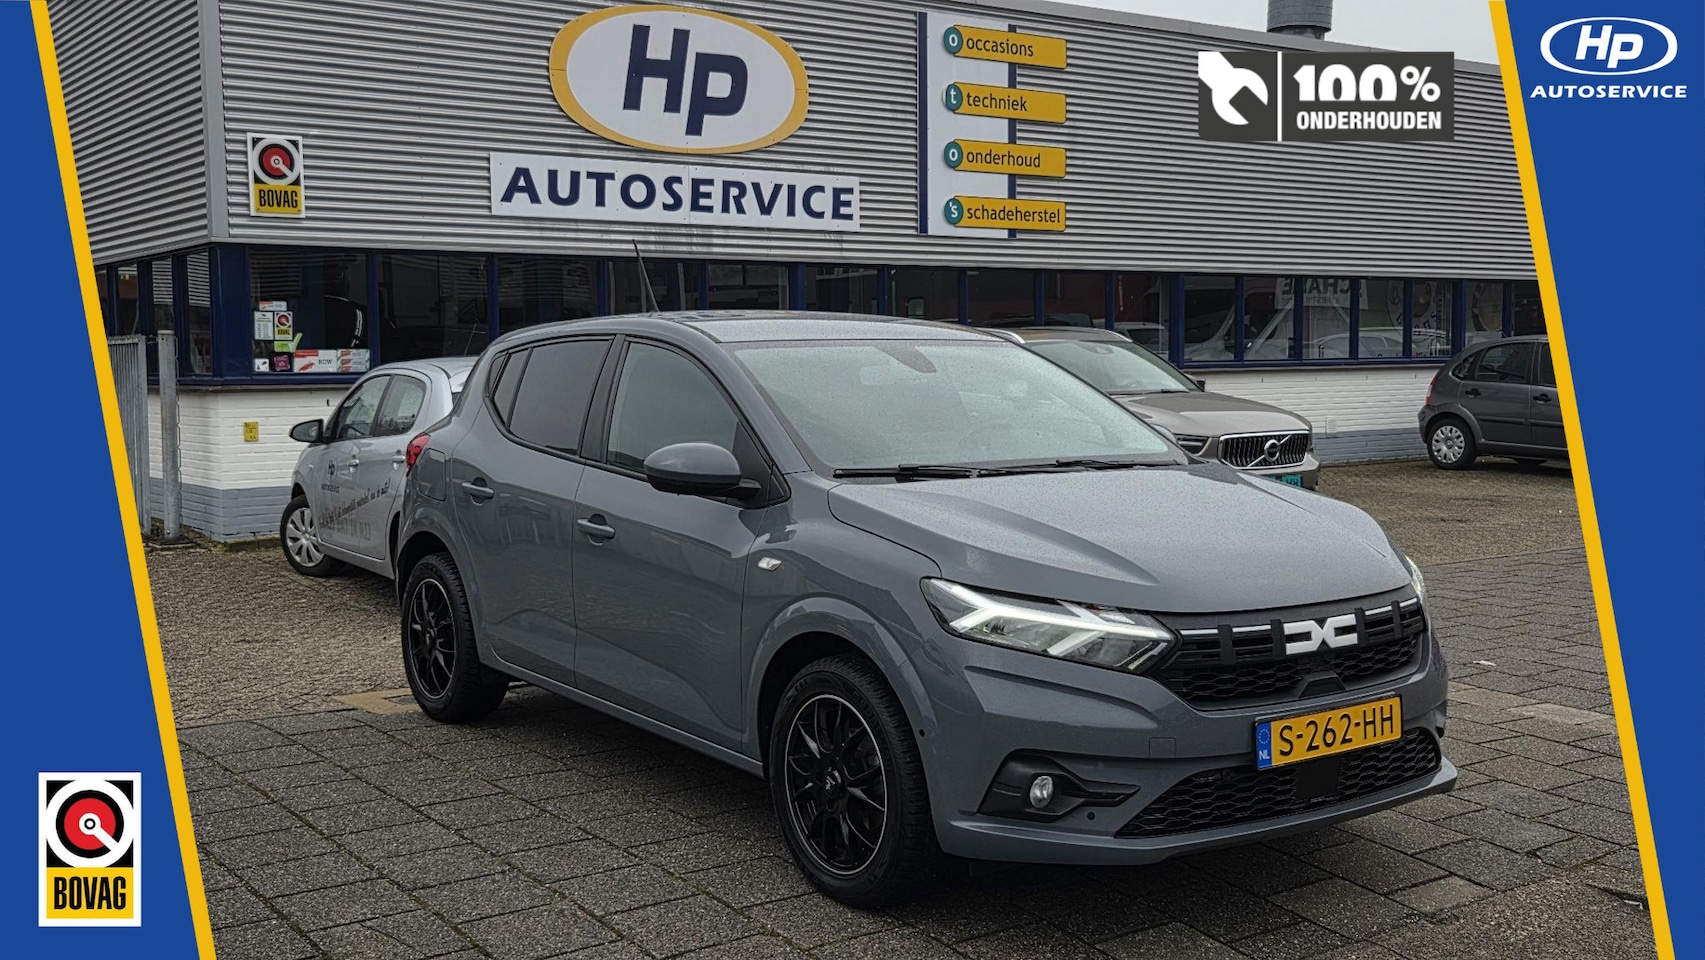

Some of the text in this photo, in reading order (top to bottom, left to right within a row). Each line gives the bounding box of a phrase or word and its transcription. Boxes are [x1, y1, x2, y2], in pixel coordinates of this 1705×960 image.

[966, 37, 1035, 58] occasions
[966, 89, 1028, 113] techniek
[966, 147, 1041, 169] onderhoud
[258, 188, 298, 209] BOVAG
[500, 167, 855, 222] AUTOSERVICE
[966, 204, 1061, 226] schadeherstel
[1259, 704, 1393, 760] NL S-262-HH
